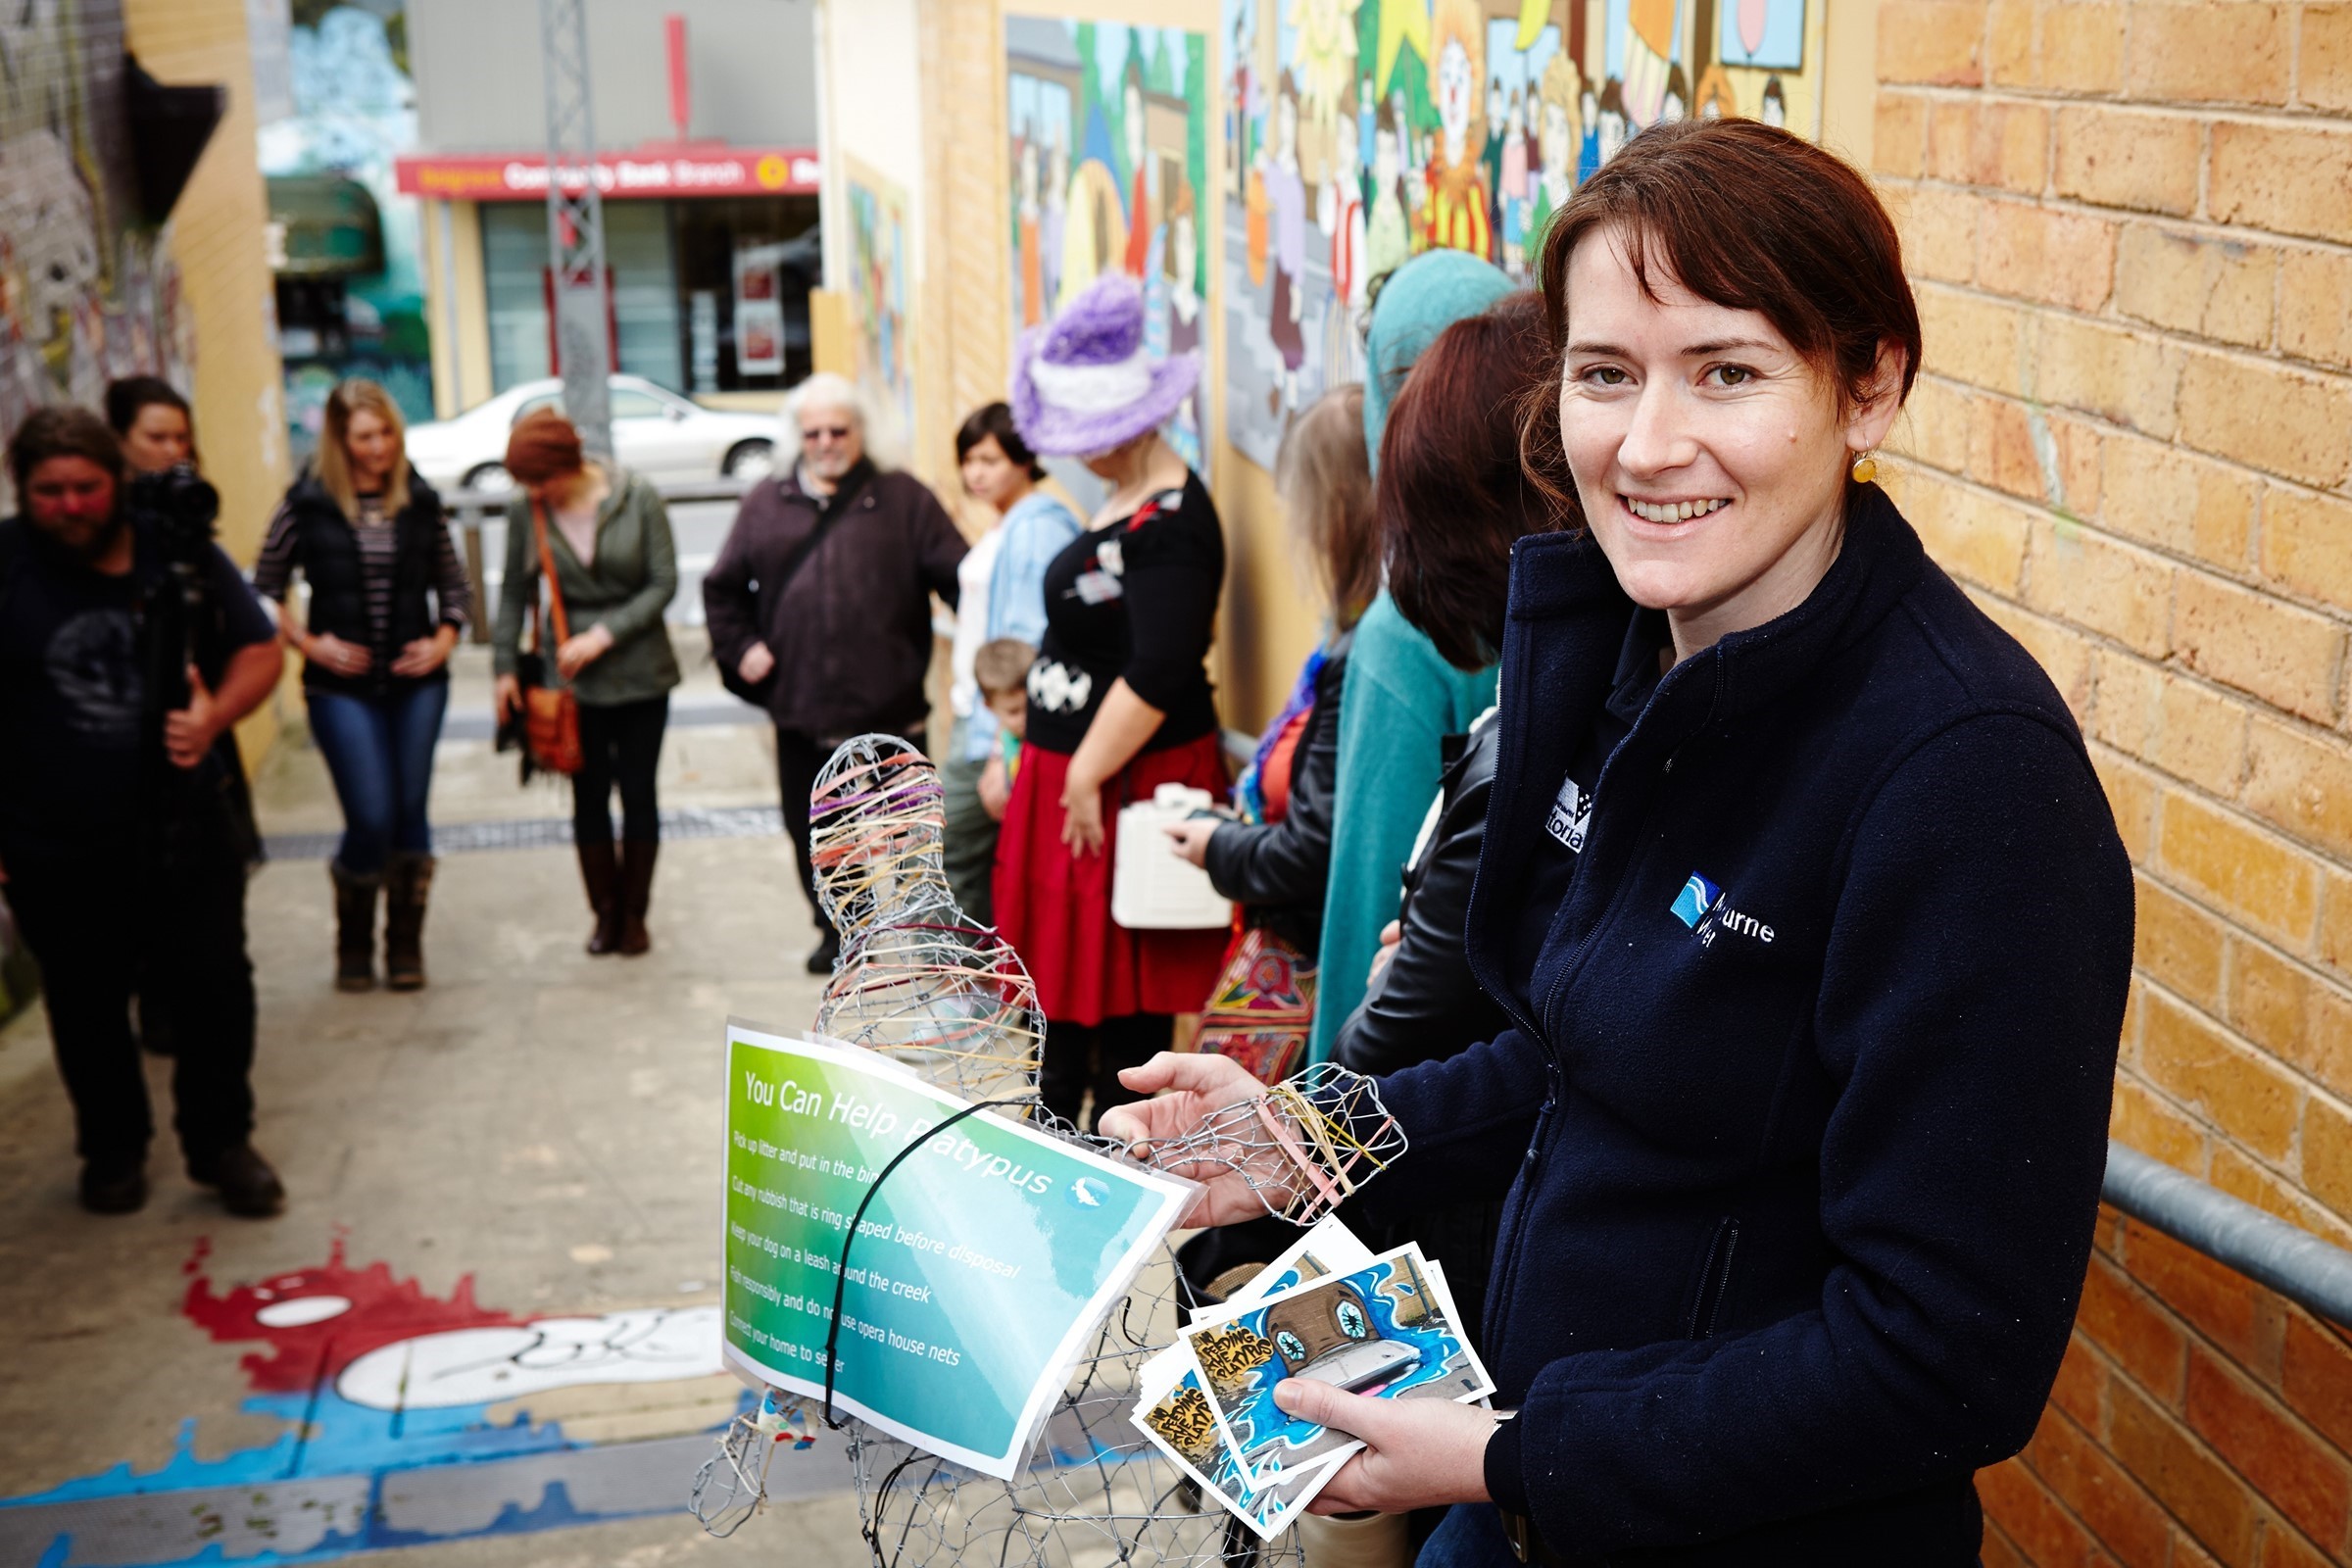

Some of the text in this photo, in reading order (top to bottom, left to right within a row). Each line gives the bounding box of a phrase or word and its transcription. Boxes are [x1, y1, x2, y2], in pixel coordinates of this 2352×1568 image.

[616, 160, 670, 187] Bank
[1547, 810, 1583, 850] toria
[733, 1130, 746, 1150] Pick
[748, 1140, 758, 1155] up
[758, 1139, 778, 1159] litter
[779, 1149, 797, 1164] and
[799, 1154, 817, 1170] put
[819, 1156, 830, 1173] in
[833, 1159, 855, 1179] the
[745, 1070, 1054, 1194] You Can Help Patypus
[732, 1175, 744, 1194] Cut
[744, 1183, 758, 1202] any
[758, 1188, 788, 1210] rubbish
[789, 1198, 808, 1217] that
[810, 1203, 819, 1220] is
[821, 1207, 843, 1231] ring
[894, 1226, 945, 1254] before
[949, 1245, 1022, 1280] disposal
[731, 1220, 932, 1303] Keep your dog on a leash arund the creek
[730, 1265, 961, 1366] Fish responsibly and do no use opera house nets
[729, 1309, 845, 1373] Connect your home to seer
[1208, 1351, 1231, 1370] THE
[1216, 1339, 1272, 1378] PLATYPUS
[1173, 1418, 1192, 1443] THE
[1184, 1401, 1213, 1446] PLATYP
